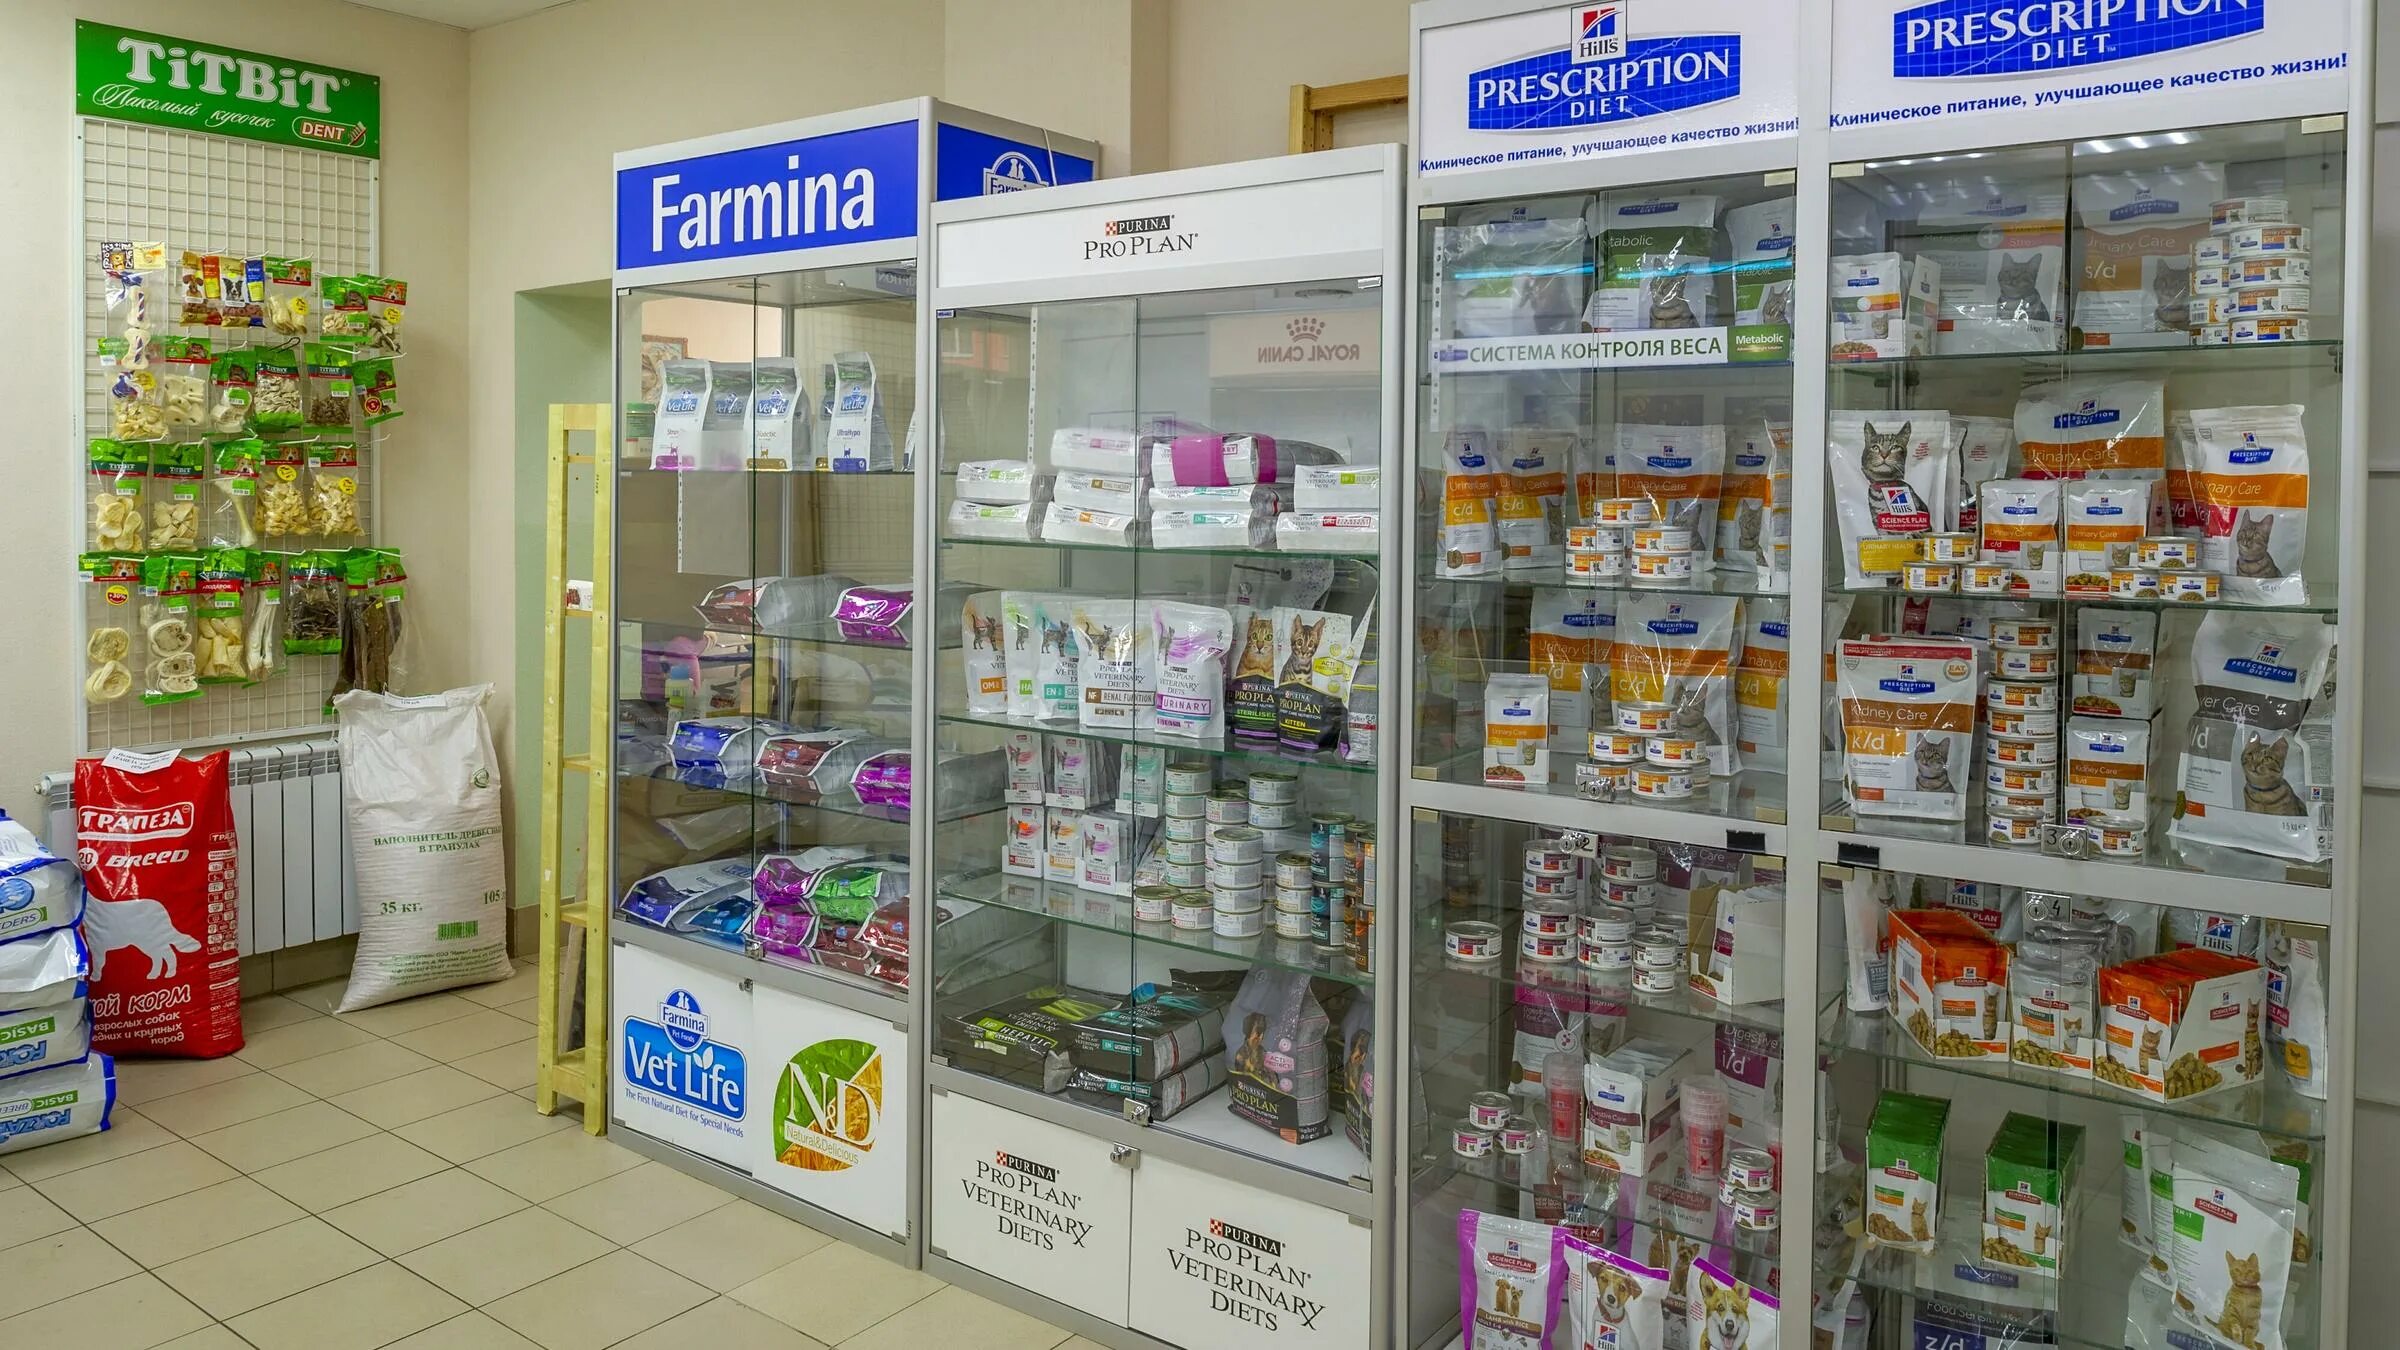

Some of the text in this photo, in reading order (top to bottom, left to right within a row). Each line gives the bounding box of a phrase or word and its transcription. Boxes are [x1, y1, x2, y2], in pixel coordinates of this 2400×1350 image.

[1579, 38, 1619, 59] Hill's
[2031, 33, 2112, 62] DIET
[1477, 48, 1730, 109] PRESCRIPTION
[1829, 52, 2349, 128] Клиническое питание, улучшающее качество жизни!
[92, 83, 276, 128] Лакомый кусочек
[1570, 95, 1629, 119] DIET
[301, 121, 346, 142] DENT
[1420, 117, 1800, 172] Клиническое питание, улучшающее качество жизни!
[652, 154, 875, 252] Farmina
[1117, 216, 1170, 233] PURINA
[1084, 234, 1195, 260] PRO PLAN
[2138, 234, 2175, 248] Care
[2085, 260, 2116, 279] s/d
[1735, 333, 1784, 345] Metabolic
[1470, 337, 1722, 363] СИСТЕМА КОНТРОЛЯ ВЕСА
[667, 402, 681, 413] Vet
[840, 400, 851, 411] Vet
[2082, 448, 2118, 462] Care
[1663, 481, 1687, 491] Care
[2237, 481, 2261, 494] Care
[1453, 504, 1473, 515] c/d
[1503, 500, 1525, 511] c/d
[1891, 503, 1913, 514] Hill's
[1881, 517, 1927, 525] SCIENCE PLAN
[1990, 540, 2002, 548] c/d
[1650, 622, 1695, 630] PRESCRIPTION
[1539, 640, 1580, 656] Urinary
[1619, 651, 1691, 670] Urinary Care
[2256, 653, 2276, 664] Hill's
[1163, 671, 1194, 681] PRO PLAN
[2231, 660, 2294, 677] PRESCRIPTION
[2250, 668, 2270, 677] DIET
[1021, 681, 1032, 690] HA
[1094, 672, 1146, 684] VETERINARY
[1107, 680, 1130, 688] DIETS
[1159, 678, 1200, 692] VETERINARY
[1618, 677, 1647, 692] c/d
[1046, 687, 1057, 696] EN
[1088, 691, 1097, 699] NF
[1103, 692, 1123, 701] RENAL
[1235, 690, 1275, 704] PRO PLA
[1163, 696, 1208, 712] URINARY
[1294, 701, 1321, 714] PLAN
[2223, 696, 2260, 716] Care
[1896, 708, 1928, 720] Care
[1284, 719, 1306, 728] KITTEN
[1852, 731, 1885, 751] k/d
[2075, 765, 2118, 775] Kidney Care
[1580, 781, 1588, 793] 1
[81, 808, 185, 831] ТРАПЕЗА
[373, 833, 457, 846] НАПОЛНИТЕЛЬ
[2046, 829, 2057, 844] 3
[418, 840, 481, 853] В ГРАНУЛАХ
[78, 852, 93, 865] 20
[105, 849, 190, 868] BREED
[1700, 848, 1725, 863] Care
[483, 890, 500, 904] 105
[1952, 894, 1978, 907] Hill's
[380, 901, 397, 915] 35
[2052, 899, 2061, 916] 4
[1973, 912, 1998, 923] PLAN
[2202, 935, 2233, 952] Hill's
[127, 984, 191, 1014] КОРМ
[94, 1010, 180, 1032] взрослых собак
[662, 1006, 705, 1034] Farmina
[1, 1021, 50, 1041] BASIC
[124, 1031, 132, 1039] и
[134, 1022, 183, 1038] крупных
[151, 1031, 185, 1045] пород
[672, 1029, 681, 1038] Pet
[1724, 1024, 1779, 1050] Digestive
[1722, 1050, 1746, 1076] i/d
[627, 1035, 740, 1112] Vet Life
[36, 1093, 75, 1108] BASIC
[788, 1062, 882, 1146] N&D
[1232, 1086, 1279, 1114] PRO PLAN
[625, 1087, 744, 1138] The First Natural Diet for Special Needs
[786, 1123, 859, 1165] Natural&Delicious
[1007, 1154, 1055, 1182] PURINA
[975, 1160, 1077, 1211] PRO PLAN
[961, 1179, 1093, 1248] VETERINARY
[998, 1216, 1054, 1251] DIETS
[1224, 1221, 1281, 1257] PURINA
[1185, 1227, 1308, 1289] PRO PLAN
[1491, 1254, 1532, 1268] SCIENCE PLAN
[1167, 1248, 1326, 1331] VETERINARY
[1210, 1289, 1278, 1333] DIETS
[1515, 1320, 1529, 1329] RICE
